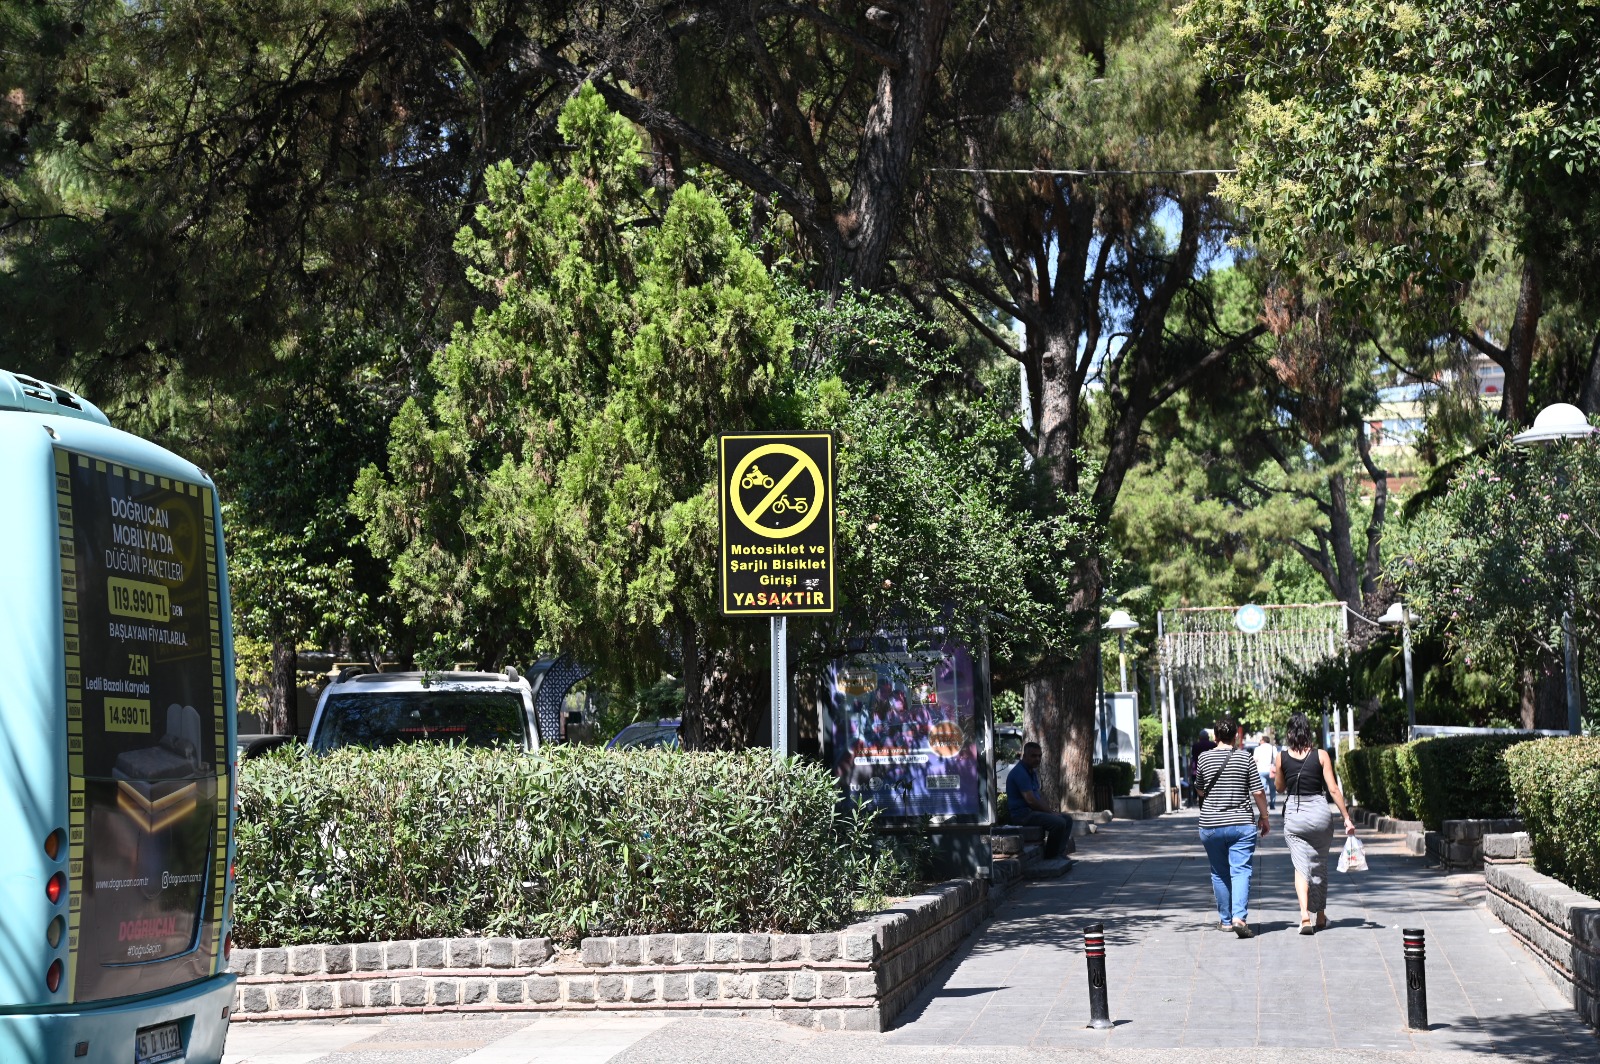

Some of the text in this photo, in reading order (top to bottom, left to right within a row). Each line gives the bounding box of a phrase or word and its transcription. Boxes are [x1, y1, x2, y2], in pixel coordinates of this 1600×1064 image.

[111, 496, 169, 529] DOĞRUCAN
[112, 523, 173, 555] MOBİLYA'DA
[731, 544, 825, 555] Motosiklet ve
[105, 547, 184, 582] DÜĞÜN PAKETLERİ
[730, 558, 826, 573] Şarjlı Bisiklet
[759, 575, 797, 588] Girişi
[112, 586, 154, 613] 119.990
[155, 594, 168, 616] TL
[733, 592, 825, 607] YASAKTIR
[109, 622, 148, 643] BAŞLAYAN
[128, 654, 149, 676] ZEN
[103, 678, 124, 692] Bazalı
[124, 680, 150, 698] Karyola
[109, 705, 149, 726] 14.990 TL
[159, 1027, 179, 1050] 0132
